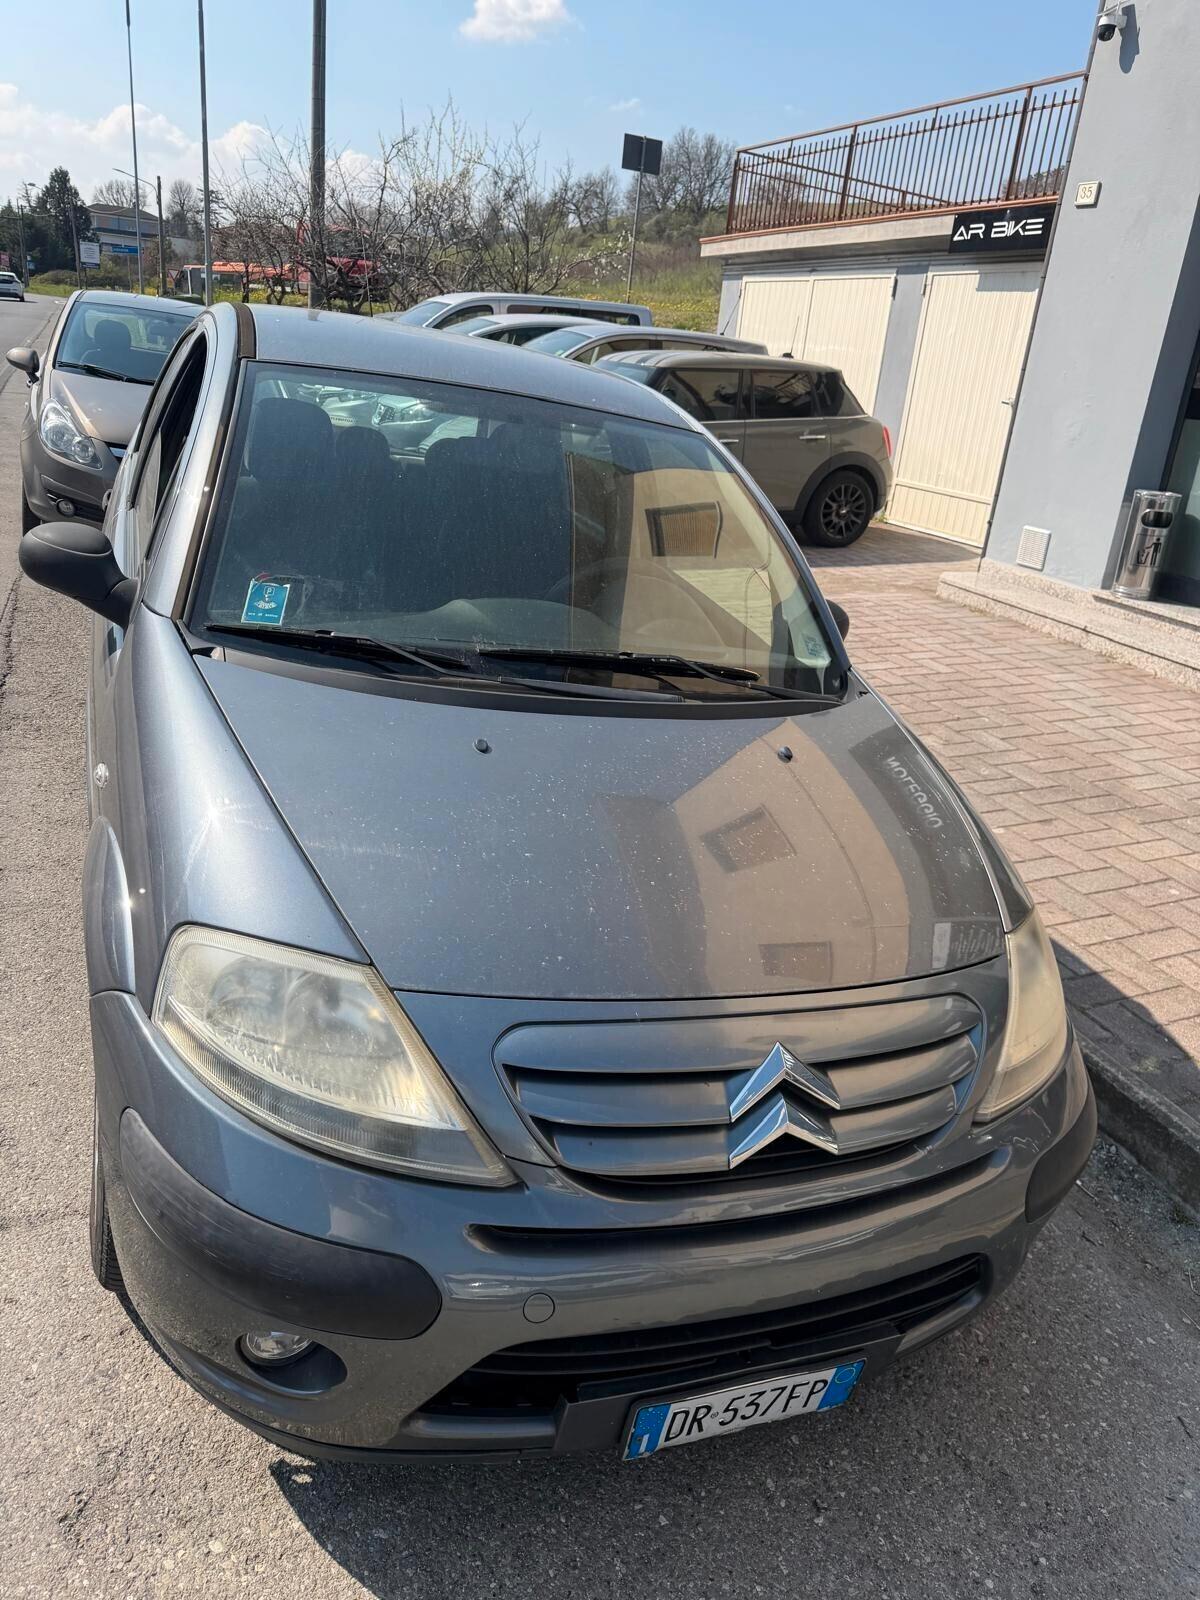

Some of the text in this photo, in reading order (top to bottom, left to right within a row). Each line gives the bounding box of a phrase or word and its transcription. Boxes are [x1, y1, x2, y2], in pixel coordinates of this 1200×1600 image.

[1080, 186, 1093, 200] 35
[953, 218, 1045, 241] AR BIKE
